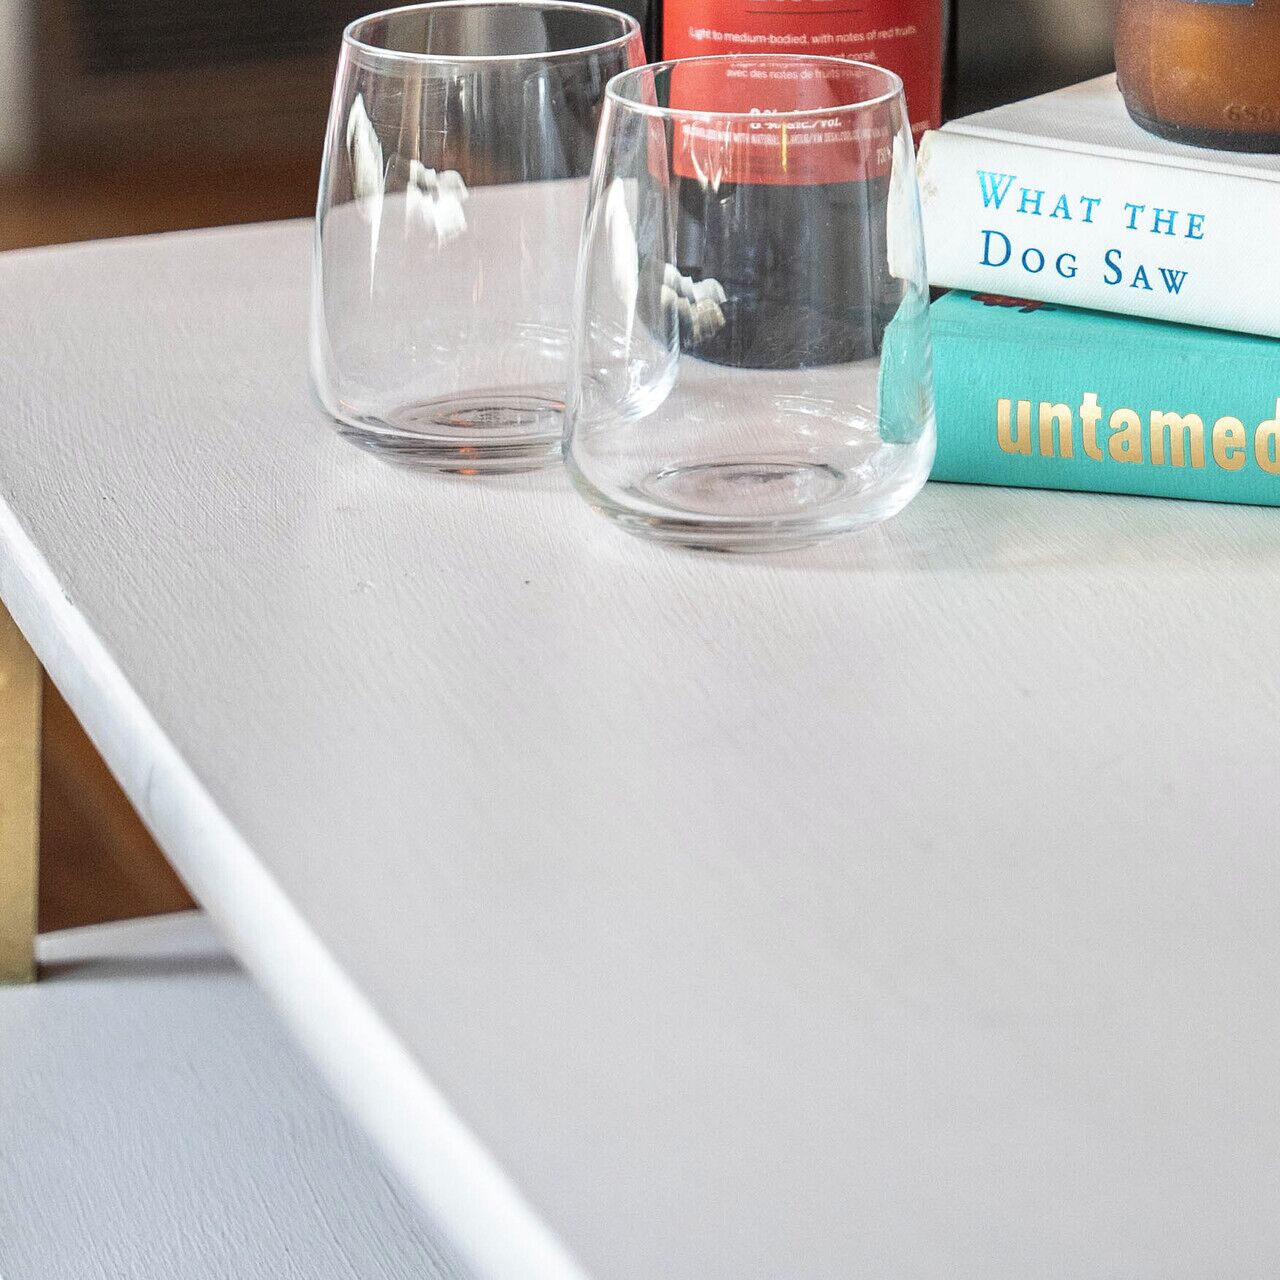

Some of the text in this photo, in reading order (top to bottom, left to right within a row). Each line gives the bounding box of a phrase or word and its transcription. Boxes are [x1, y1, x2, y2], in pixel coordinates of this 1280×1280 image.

[811, 32, 834, 44] with
[835, 31, 865, 42] notes
[865, 28, 877, 40] of
[877, 27, 894, 39] red
[726, 69, 748, 79] avec
[749, 68, 768, 79] des
[769, 70, 799, 80] notes
[799, 68, 814, 80] de
[976, 169, 1206, 240] WHAT THE
[978, 229, 1189, 295] DOG SAW
